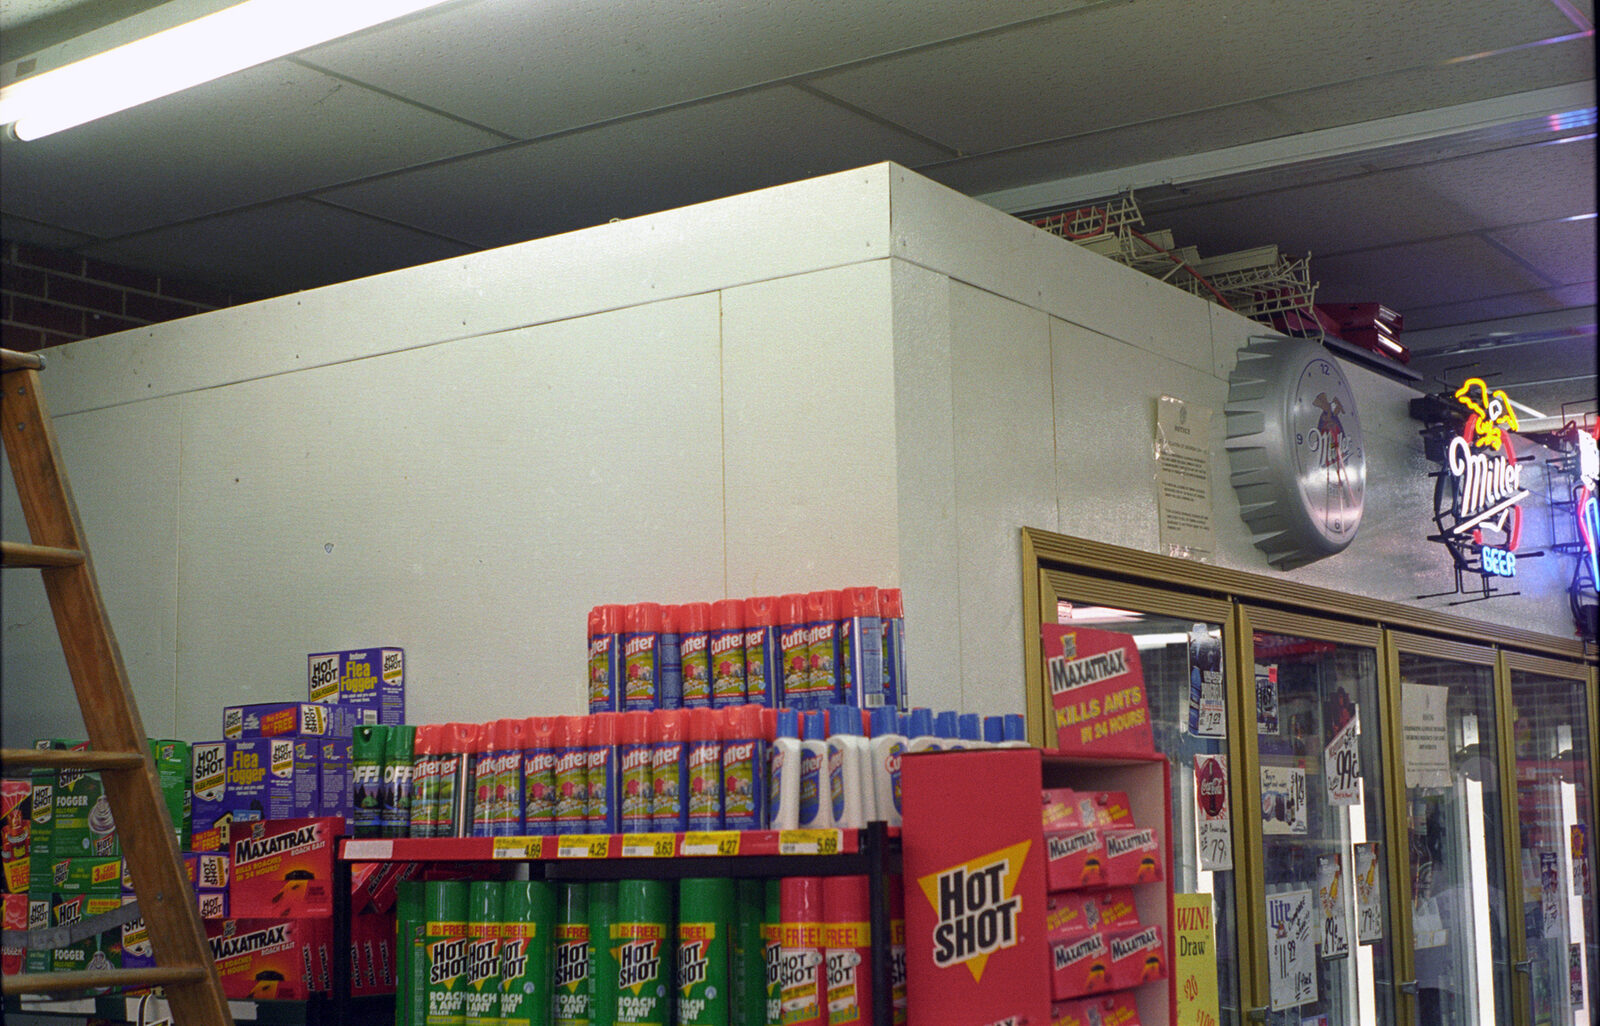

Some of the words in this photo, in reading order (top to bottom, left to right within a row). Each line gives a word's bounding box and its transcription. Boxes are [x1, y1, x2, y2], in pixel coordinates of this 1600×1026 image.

[1320, 363, 1331, 376] 12
[1296, 433, 1304, 445] 9
[1449, 437, 1523, 518] Miller
[1334, 519, 1341, 530] 6
[1482, 546, 1516, 577] BEER
[383, 660, 402, 672] SHOT
[385, 653, 399, 664] HOT
[313, 659, 333, 677] HOT
[346, 661, 370, 678] Flea
[311, 669, 338, 689] SHOT
[340, 676, 378, 693] Fogger
[227, 711, 240, 721] HOT
[1056, 699, 1102, 729] KILLS
[1103, 687, 1142, 716] ANTS
[225, 718, 242, 730] SHOT
[274, 716, 294, 735] FREE
[303, 711, 311, 731] HOT
[309, 706, 319, 734] SHOT
[1081, 724, 1092, 744] IN
[1094, 719, 1108, 739] 24
[198, 748, 220, 765] HOT
[272, 751, 292, 763] SHOT
[274, 745, 290, 755] HOT
[195, 758, 225, 779] SHOT
[232, 751, 259, 769] Flea
[227, 766, 266, 785] Fogger
[36, 787, 49, 799] HOT
[57, 796, 88, 806] FOGGER
[33, 795, 53, 811] SHOT
[234, 824, 317, 866] MAXATTRAX
[312, 841, 326, 851] BAIT
[524, 843, 541, 858] 4.69
[588, 842, 607, 857] 4.25
[654, 841, 674, 856] 3.63
[718, 840, 738, 855] 4.27
[816, 838, 838, 854] 5.69
[94, 867, 101, 882] 3
[202, 862, 212, 884] HOT
[210, 857, 219, 886] SHOT
[939, 860, 1007, 923] HOT
[31, 903, 46, 916] HOT
[201, 905, 223, 919] SHOT
[202, 897, 219, 910] HOT
[30, 911, 49, 925] SHOT
[58, 901, 80, 924] HOT
[1176, 905, 1210, 931] WIN!
[1269, 899, 1311, 930] Lite
[474, 926, 501, 940] FREE!
[631, 926, 661, 939] FREE!
[786, 928, 821, 946] FREE!
[934, 897, 1019, 965] SHOT
[54, 949, 85, 961] FOGGER
[433, 939, 466, 966] HOT
[558, 942, 588, 967] HOT
[621, 942, 656, 968] HOT
[768, 944, 781, 966] OT
[1179, 936, 1206, 957] Draw
[469, 941, 498, 971] HOT
[828, 954, 845, 972] OT
[431, 956, 468, 984] SHOT
[620, 958, 661, 988] SHOT
[781, 965, 816, 988] SHOT
[430, 991, 466, 1002] ROACH
[1183, 974, 1199, 1002] $20
[430, 1000, 438, 1012] &
[439, 1000, 463, 1012] ANT
[470, 1003, 492, 1015] ANT
[563, 1004, 586, 1014] ANT
[618, 996, 656, 1009] ROACH
[627, 1007, 653, 1019] ANT
